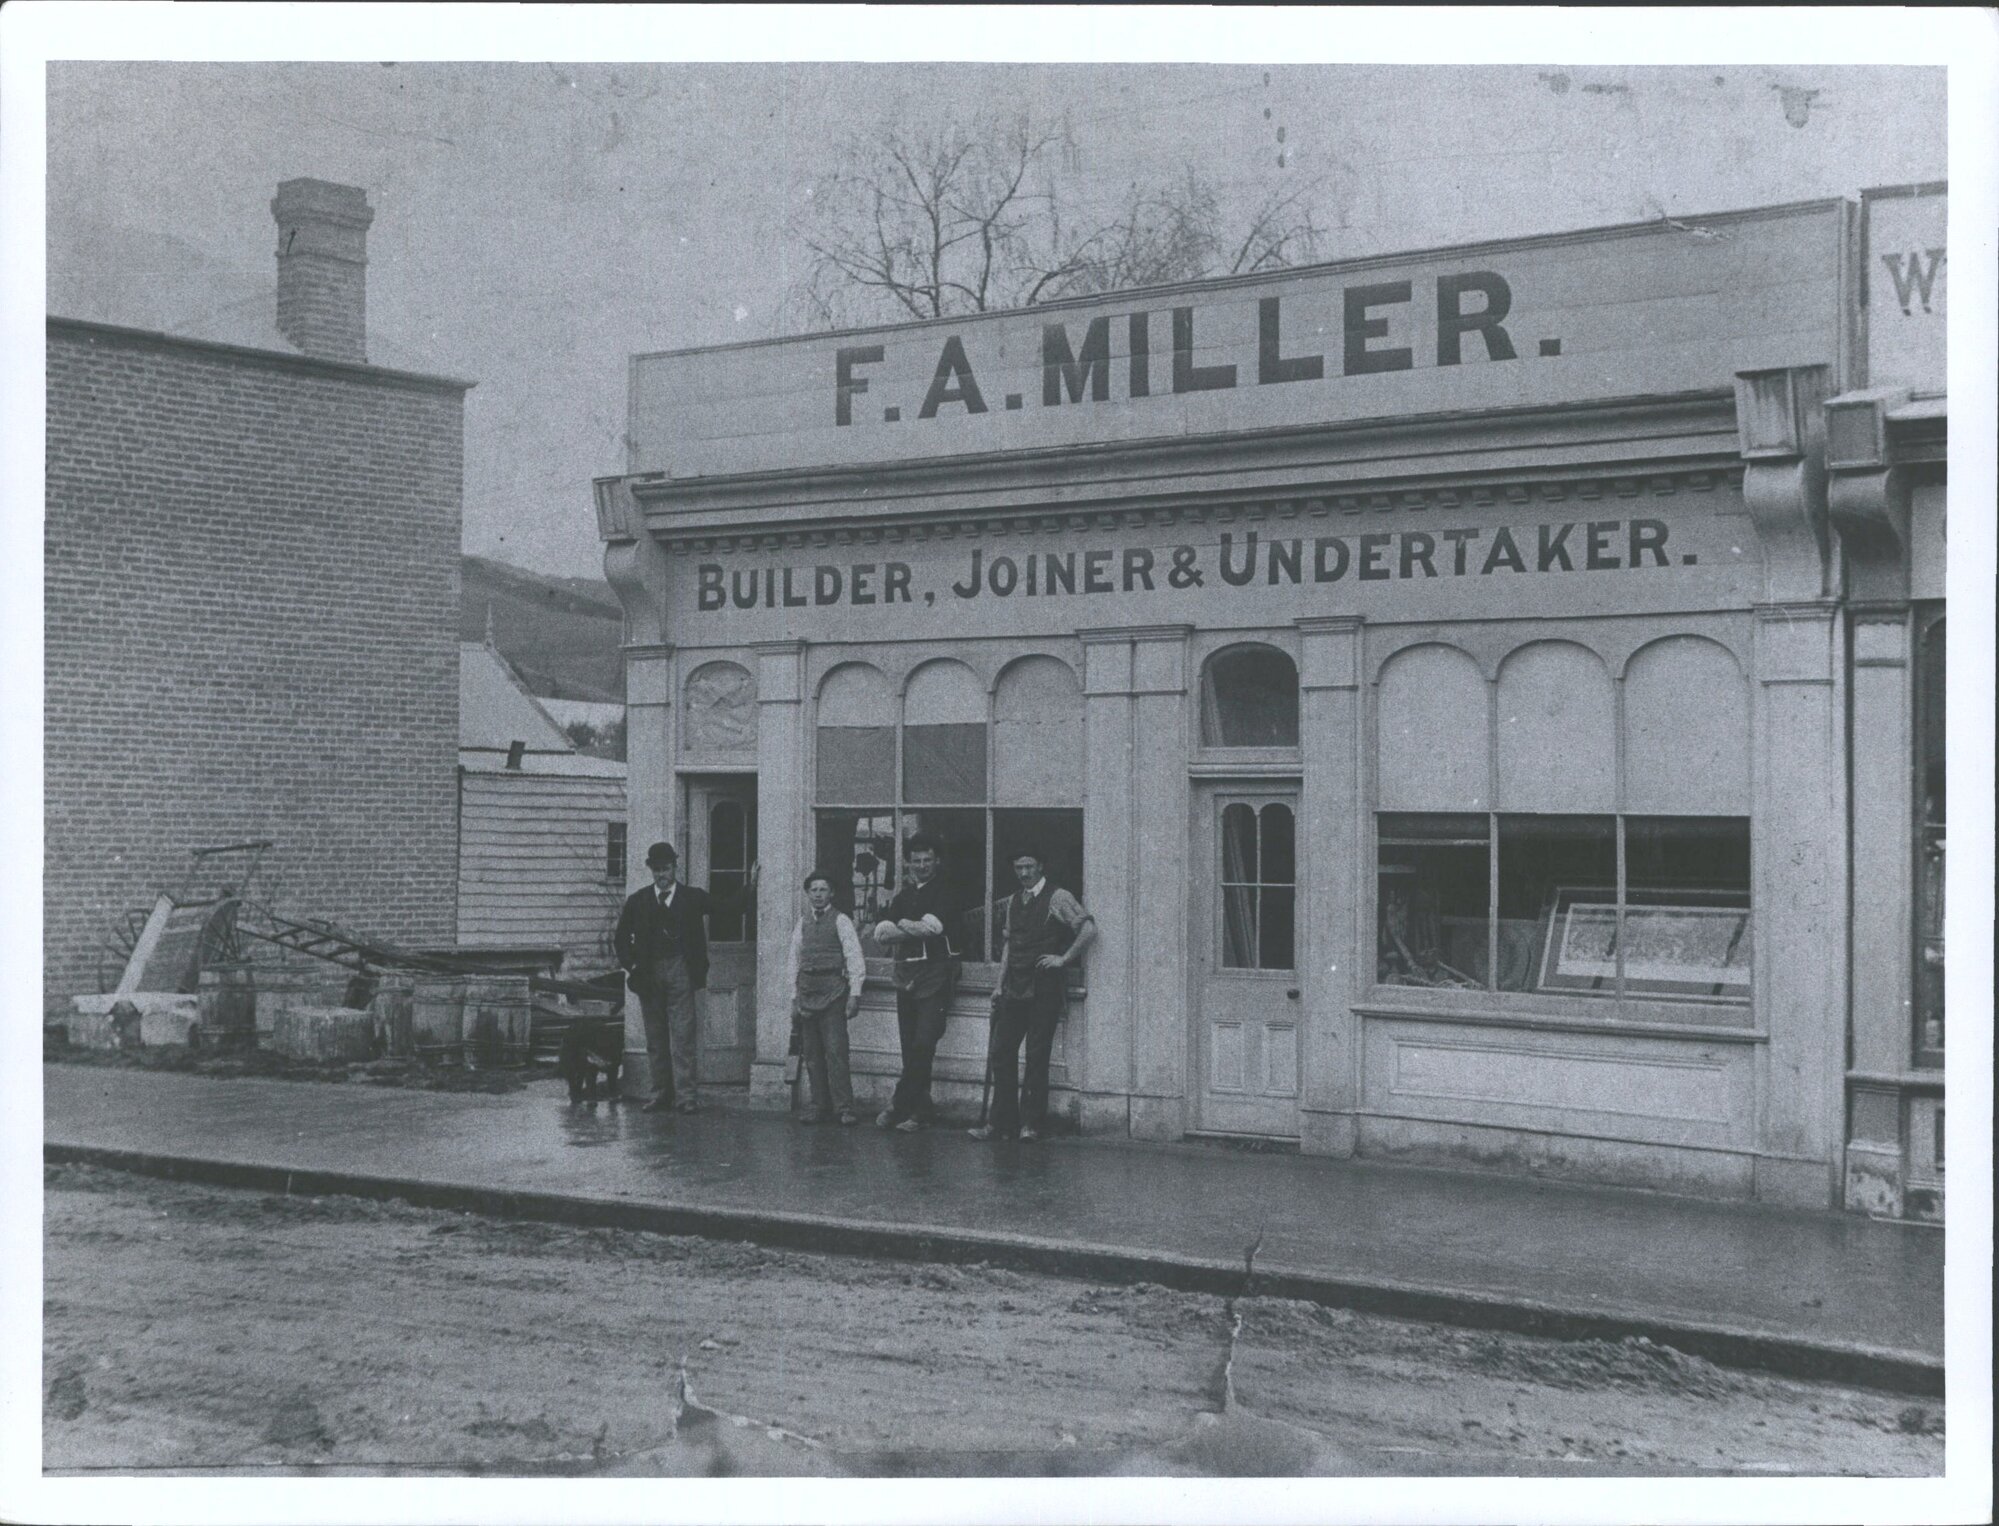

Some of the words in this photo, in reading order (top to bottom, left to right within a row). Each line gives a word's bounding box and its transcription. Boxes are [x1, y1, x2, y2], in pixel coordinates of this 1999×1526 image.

[834, 344, 901, 427] F.
[917, 335, 1024, 419] A.
[1041, 270, 1562, 408] MILLER.
[697, 562, 935, 611] BUILDER,
[951, 547, 1155, 600] JOINER
[1167, 543, 1205, 589] &
[1218, 518, 1698, 588] UNDERTAKER.
